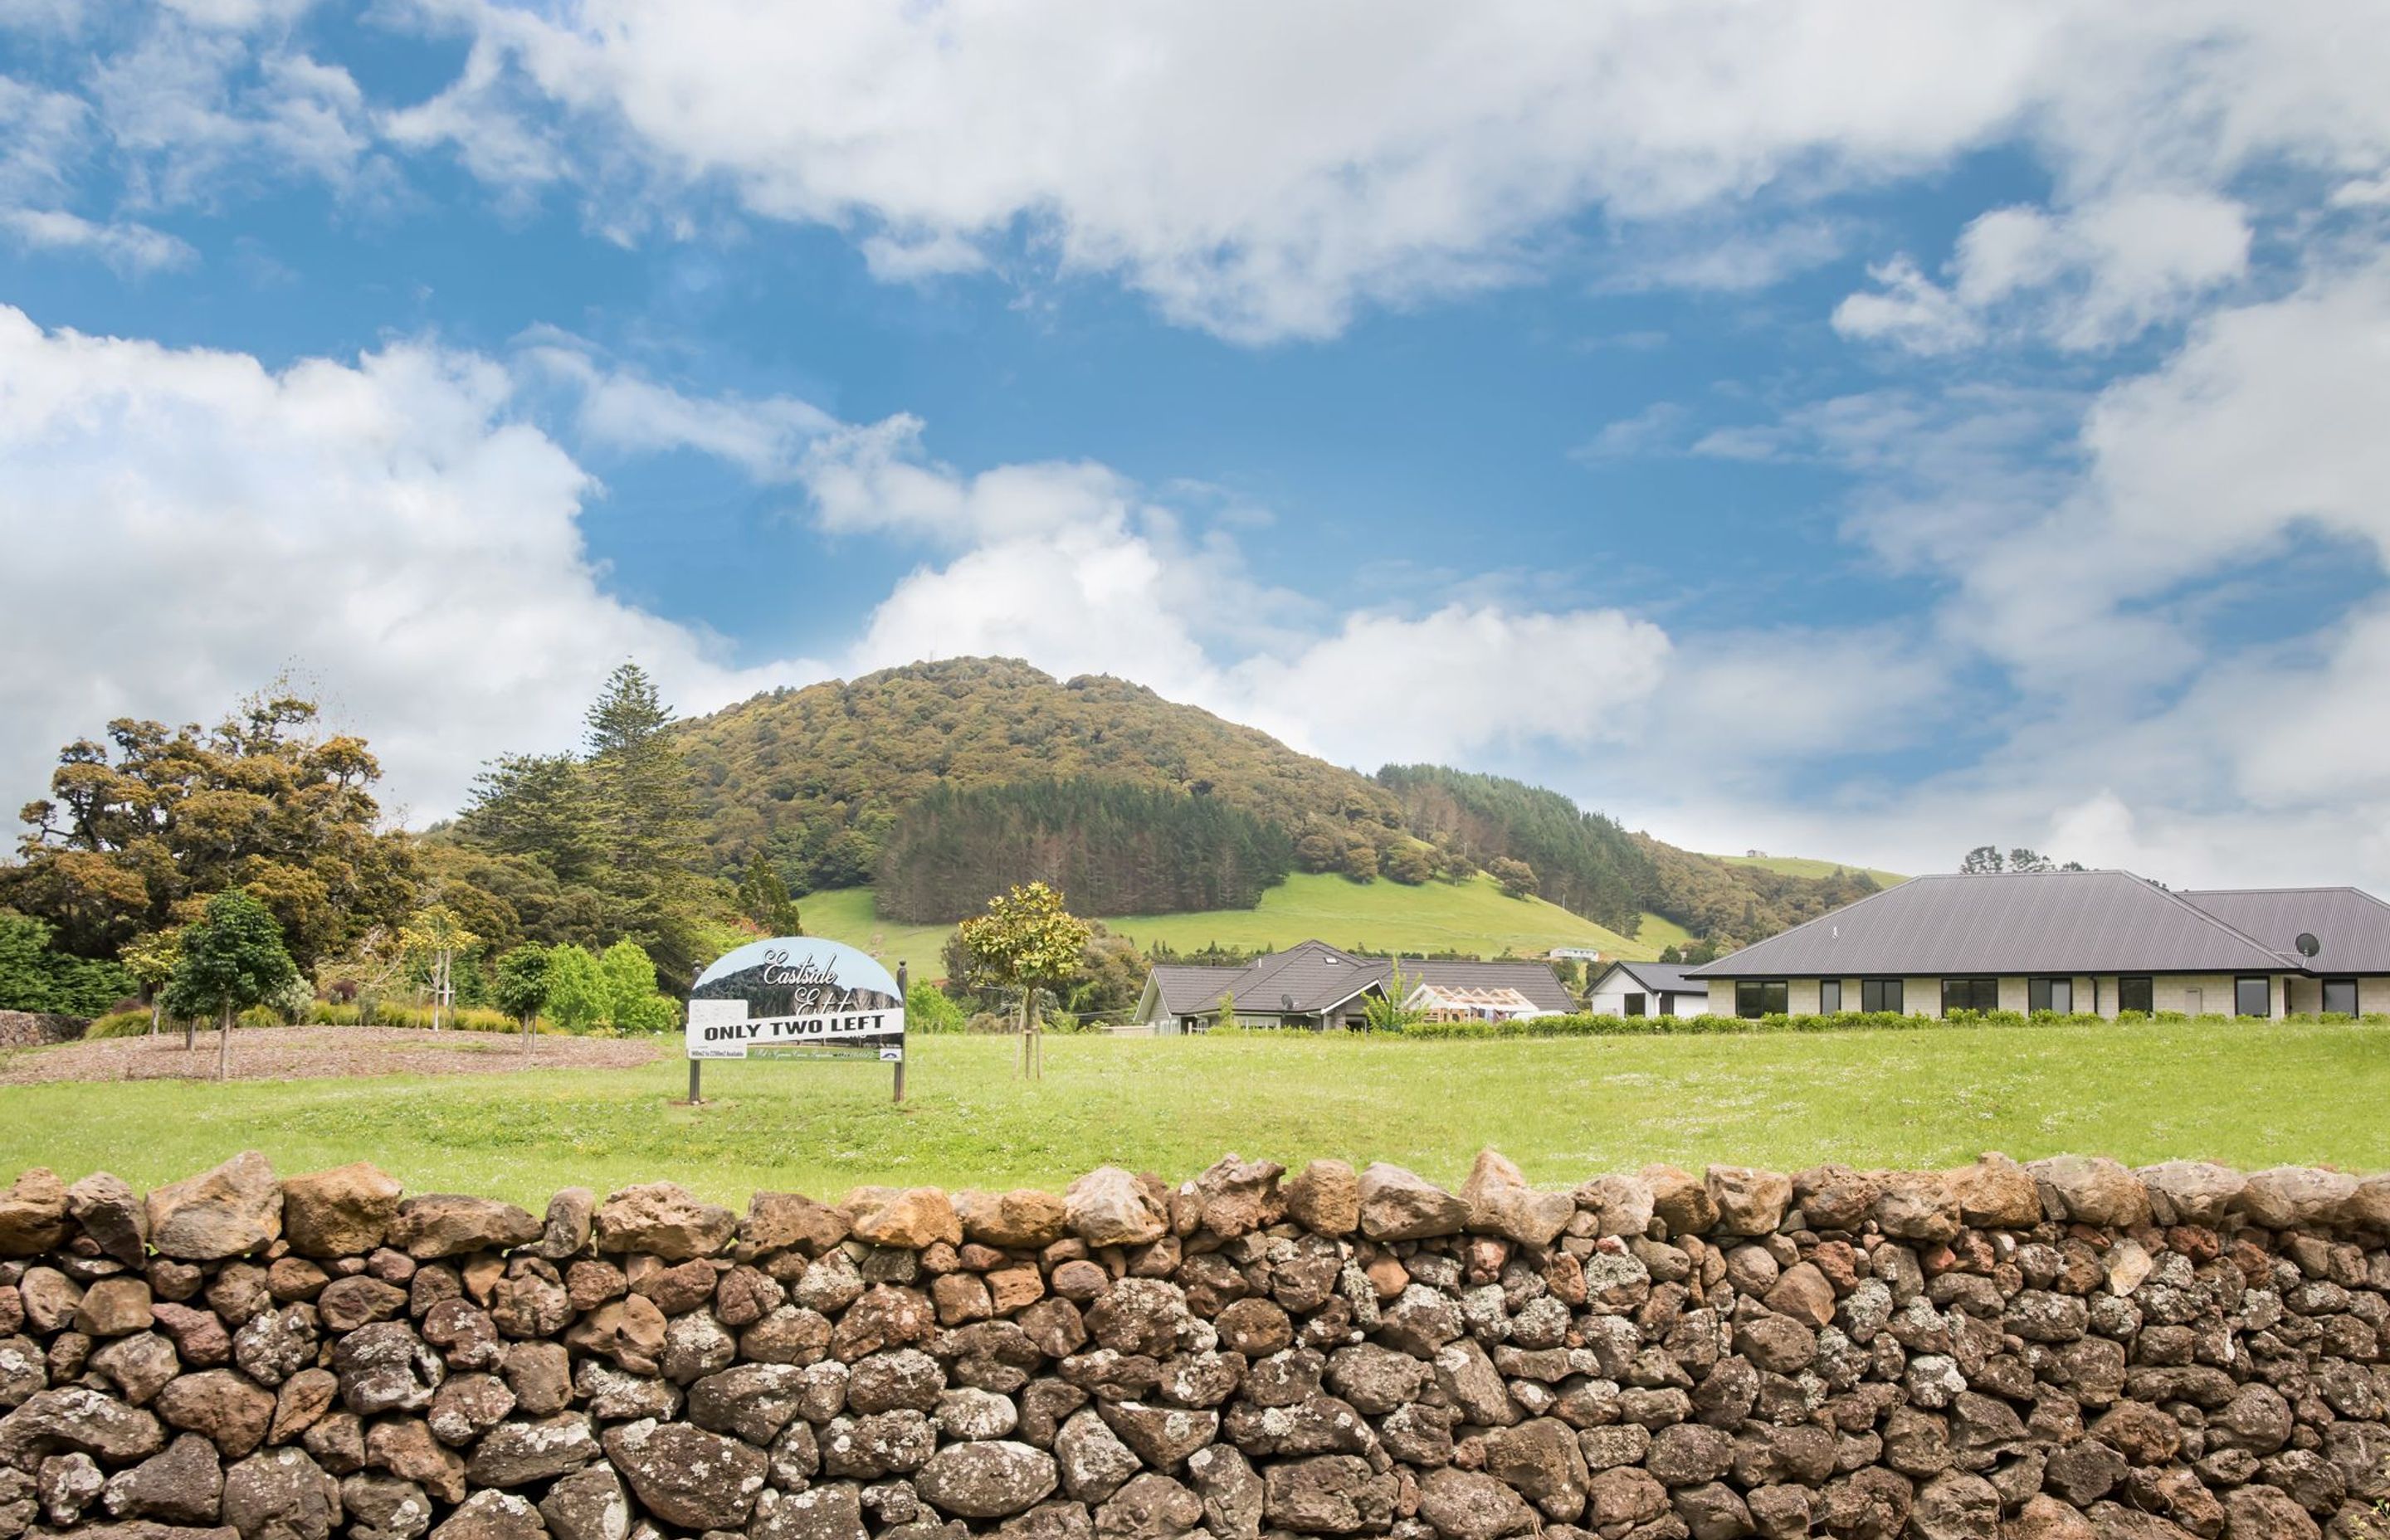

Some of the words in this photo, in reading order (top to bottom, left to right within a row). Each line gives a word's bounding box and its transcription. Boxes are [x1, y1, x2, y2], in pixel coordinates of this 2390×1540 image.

[763, 948, 837, 985] Eastside
[705, 1023, 761, 1040] ONLY
[770, 1021, 822, 1036] TWO
[831, 1015, 885, 1031] LEFT
